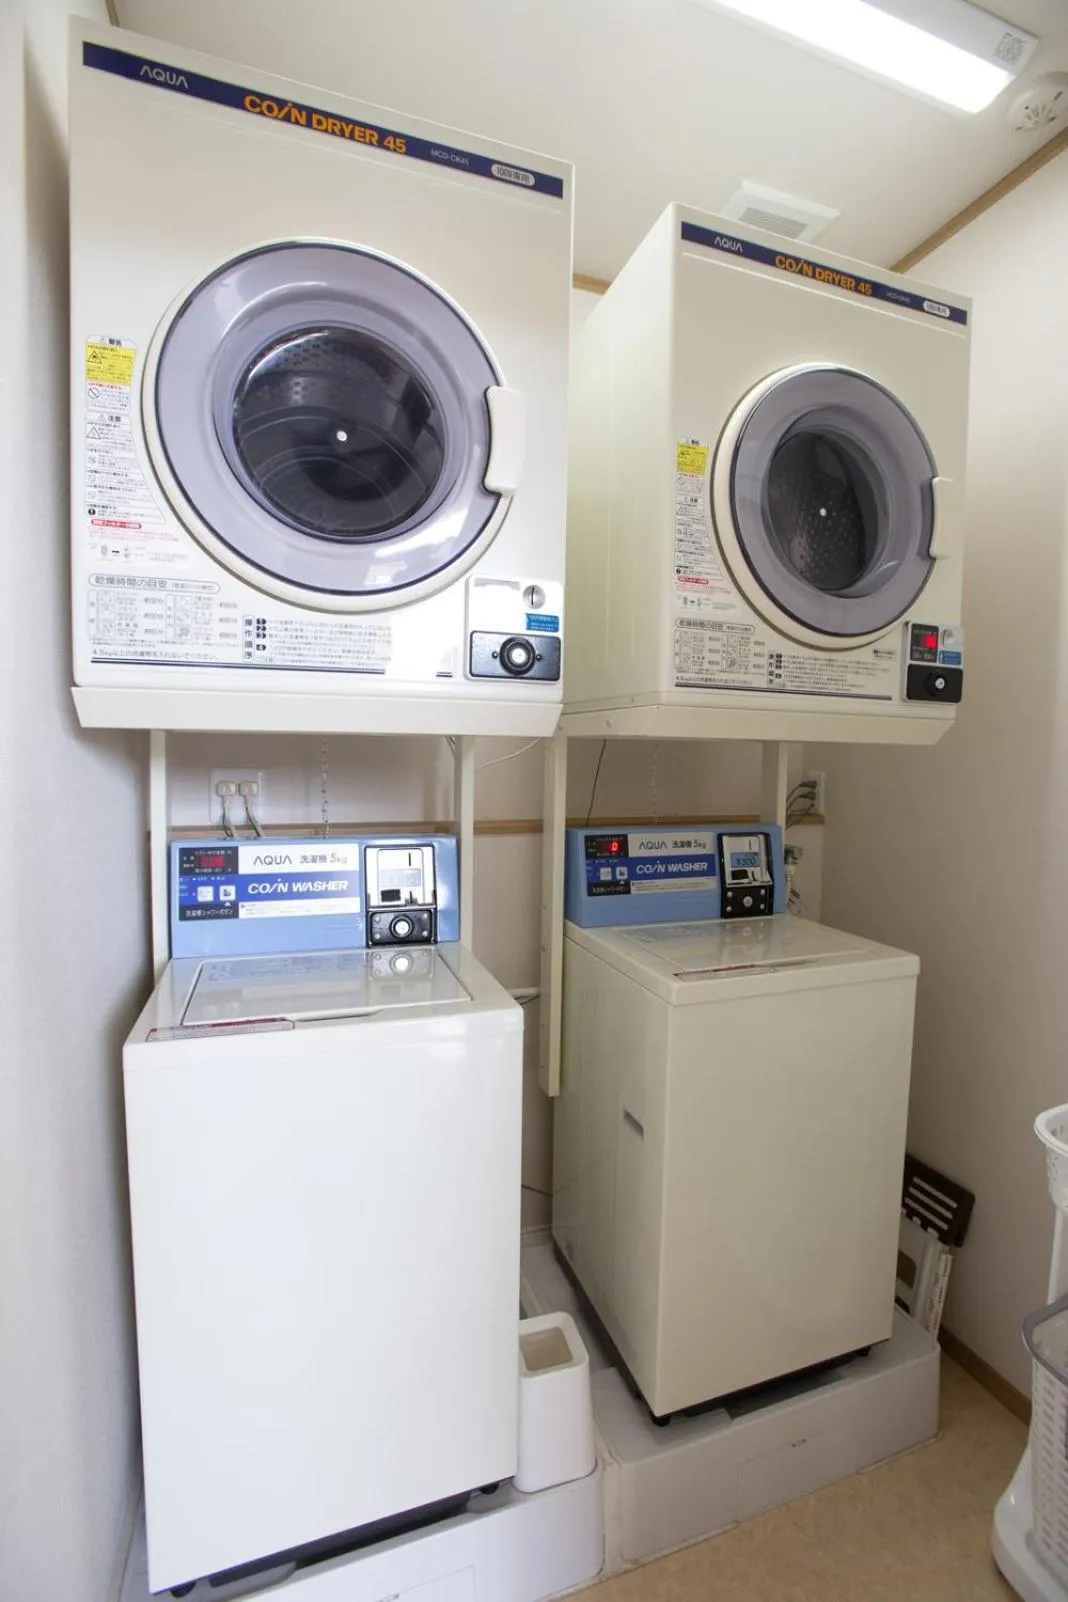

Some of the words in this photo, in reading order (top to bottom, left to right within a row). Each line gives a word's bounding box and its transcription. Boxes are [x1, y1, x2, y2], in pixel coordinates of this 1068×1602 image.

[139, 64, 189, 89] AQUA
[311, 113, 379, 146] DRYER
[383, 135, 407, 154] 45
[713, 235, 743, 253] AQUA
[815, 267, 856, 291] DRYER
[858, 281, 872, 296] 45
[639, 840, 668, 850] AQUA
[253, 854, 293, 866] AQUA
[329, 852, 348, 865] 5kg
[667, 861, 708, 873] WASHER
[292, 880, 349, 893] WASHER
